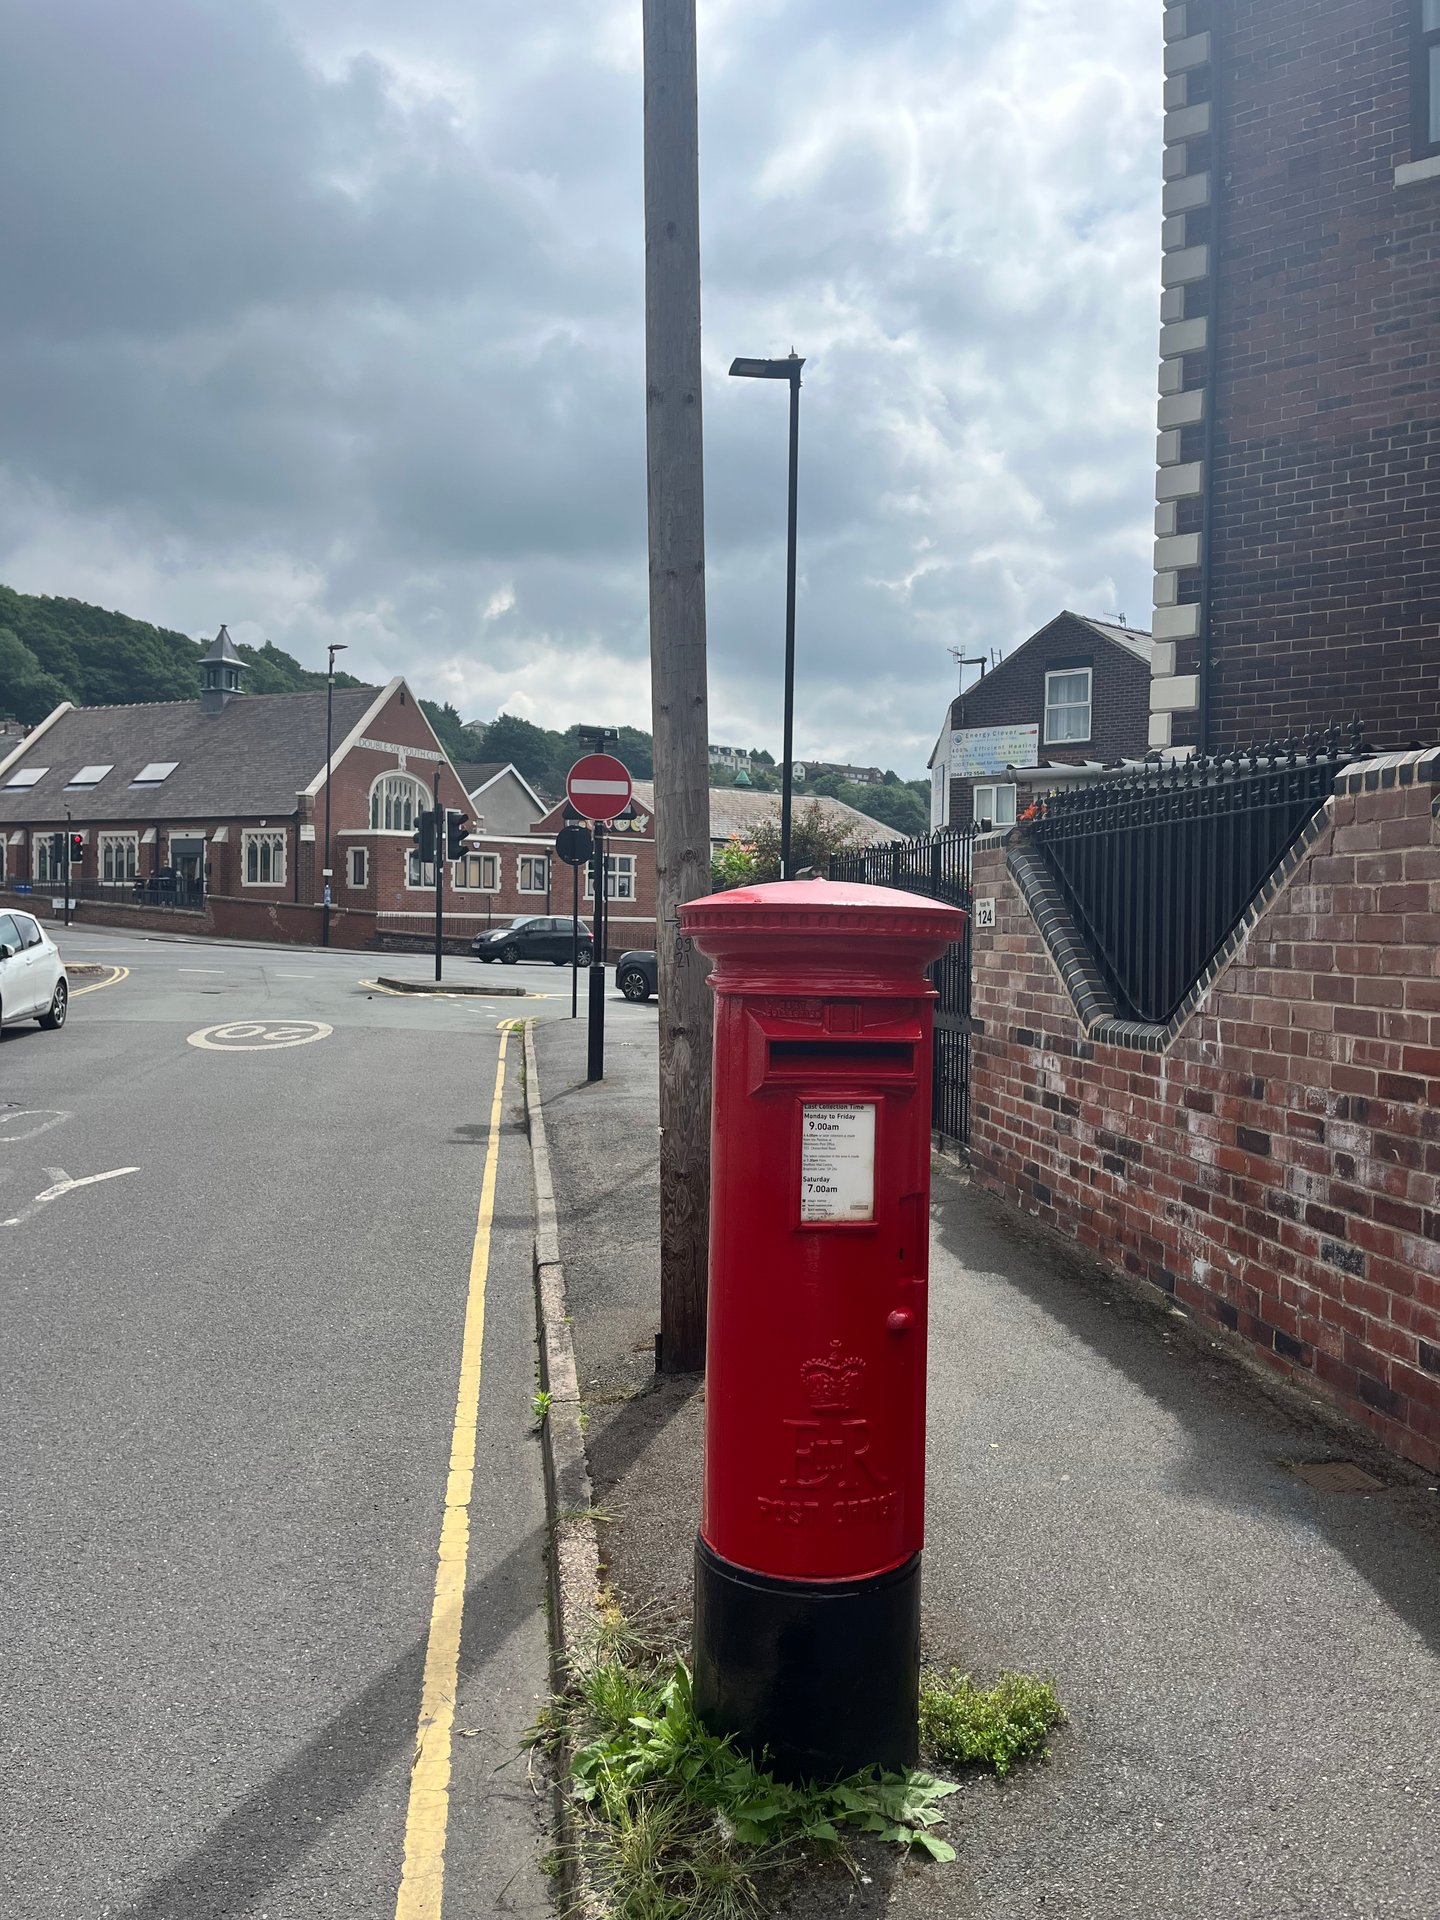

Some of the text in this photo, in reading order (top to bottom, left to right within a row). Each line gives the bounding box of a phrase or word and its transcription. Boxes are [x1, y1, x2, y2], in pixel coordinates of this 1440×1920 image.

[965, 731, 990, 739] Energy
[359, 739, 388, 751] DOUBLE
[390, 743, 401, 753] SIX
[402, 746, 426, 757] YOUTH
[977, 910, 992, 924] 124
[214, 1025, 314, 1041] 20
[808, 1121, 840, 1131] 9.00am
[807, 1184, 838, 1193] 7.00am
